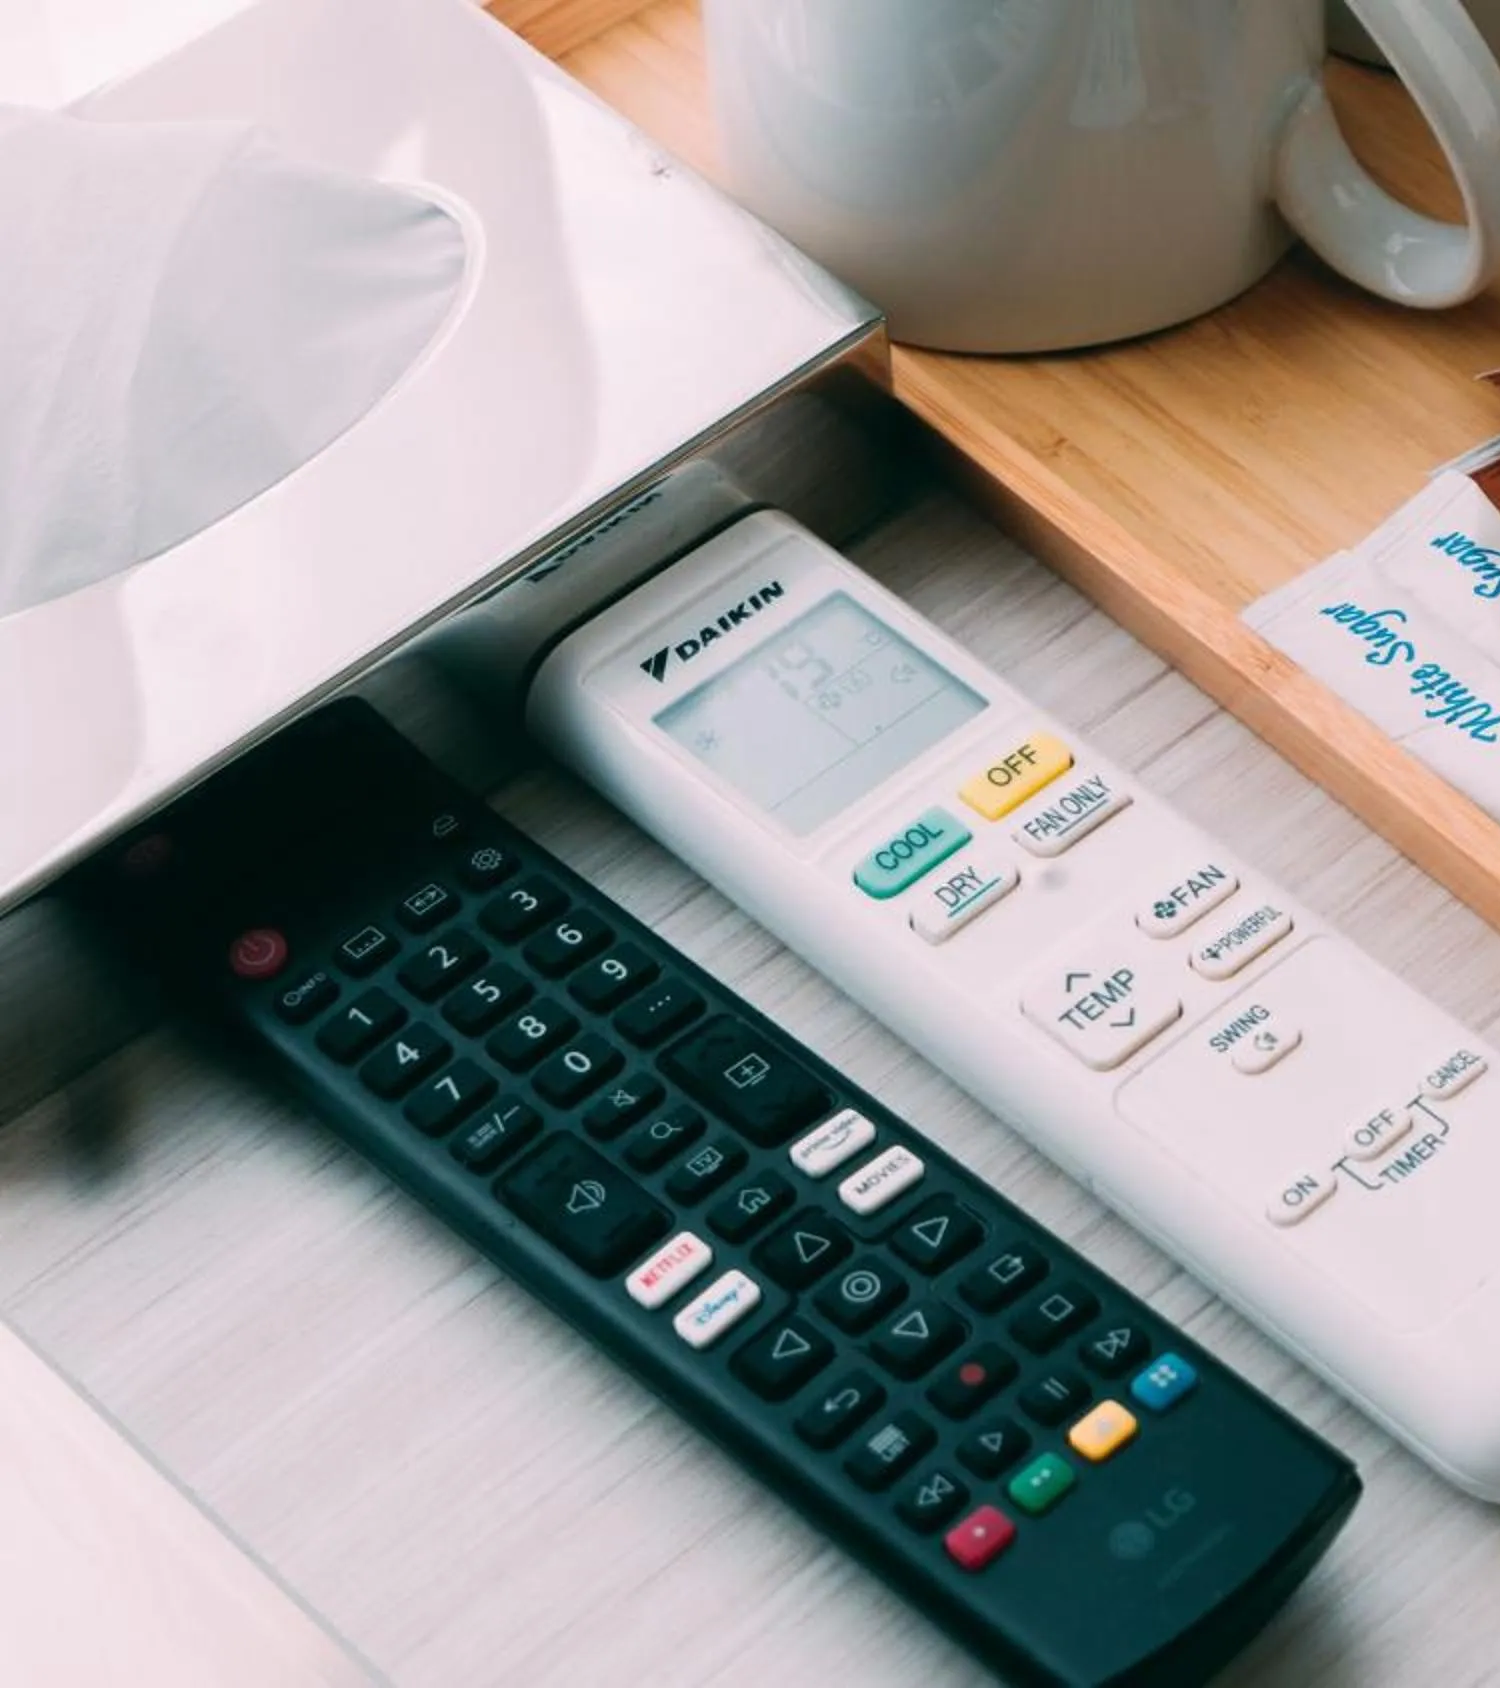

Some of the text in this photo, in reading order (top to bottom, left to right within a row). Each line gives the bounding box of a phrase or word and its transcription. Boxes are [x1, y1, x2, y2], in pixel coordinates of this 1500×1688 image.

[675, 581, 785, 662] DAIKIN
[1320, 602, 1415, 666] Sugar
[987, 744, 1039, 787] OFF
[1024, 775, 1112, 841] FAN ONLY
[875, 822, 944, 871] COOL
[510, 890, 538, 911] 3
[934, 866, 984, 907] DRY
[1170, 864, 1226, 906] FAN
[556, 923, 583, 945] 6
[1219, 905, 1283, 952] POWERFUL
[428, 945, 459, 971] 2
[601, 959, 628, 980] 9
[472, 979, 500, 1002] 5
[1057, 968, 1135, 1031] TEMP
[348, 1006, 373, 1027] 1
[518, 1015, 547, 1039] 8
[1209, 1004, 1271, 1053] SWING
[395, 1041, 420, 1066] 4
[564, 1051, 592, 1073] 0
[1426, 1048, 1482, 1089] CANCEL
[434, 1076, 461, 1101] 7
[1353, 1108, 1397, 1147] OFF
[1377, 1131, 1446, 1185] TIMER
[1281, 1174, 1320, 1208] ON
[1146, 1487, 1196, 1530] LG
